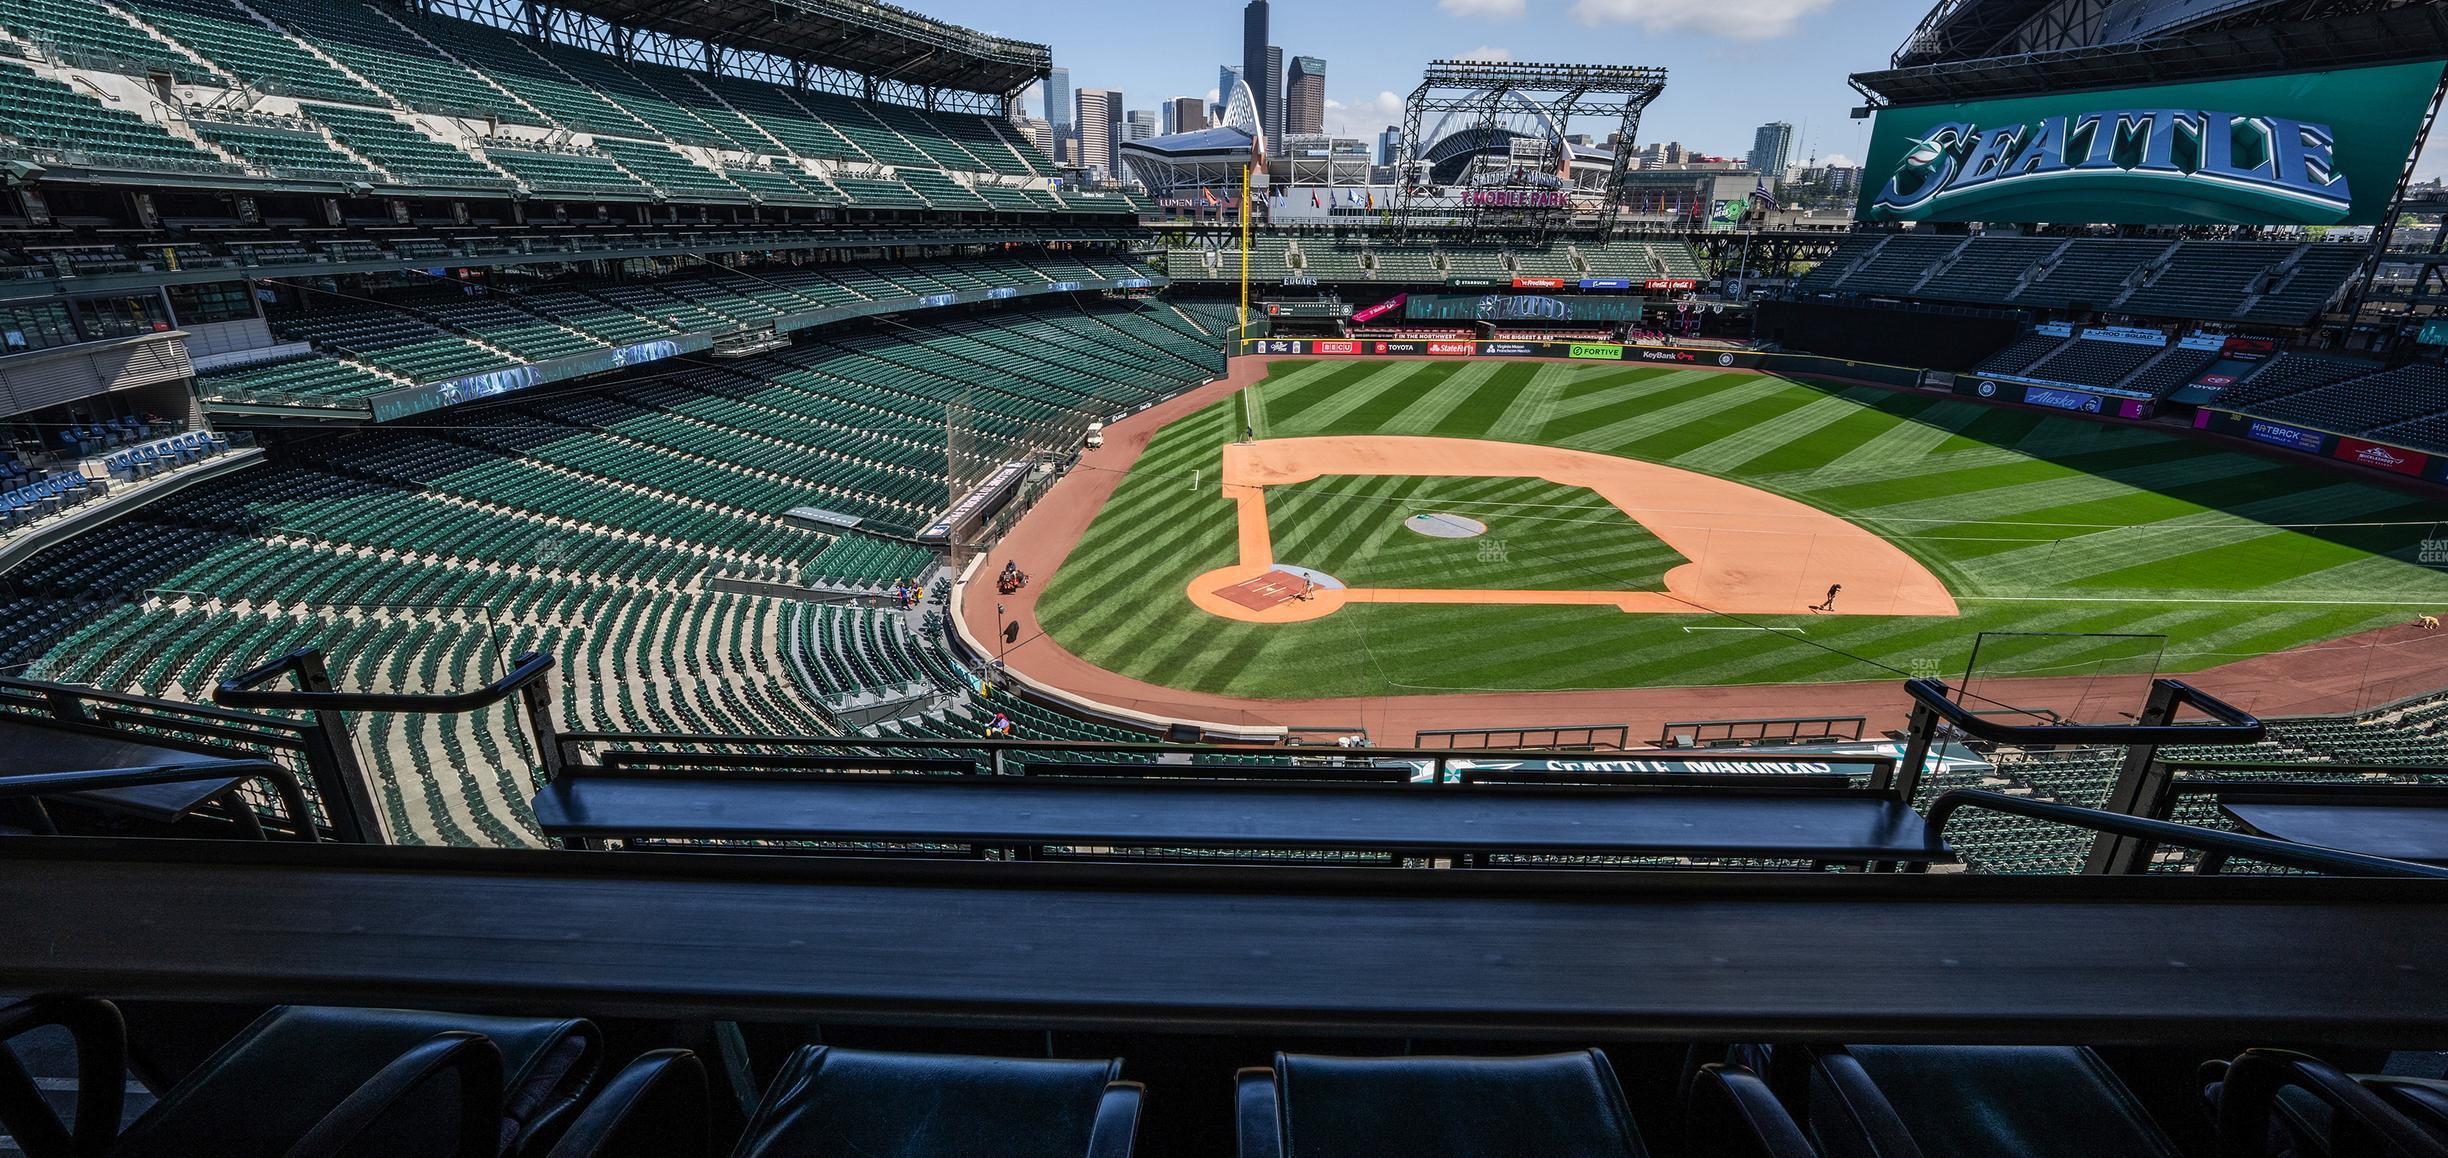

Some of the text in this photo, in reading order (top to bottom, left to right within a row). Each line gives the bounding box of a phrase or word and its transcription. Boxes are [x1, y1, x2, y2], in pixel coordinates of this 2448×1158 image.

[1873, 108, 2350, 212] SEATTLE
[1531, 191, 1568, 206] PARK
[1323, 343, 1351, 351] BECU
[1643, 351, 1676, 360] KeyBank
[2030, 391, 2075, 408] Alaska
[2252, 423, 2300, 440] HATBACK
